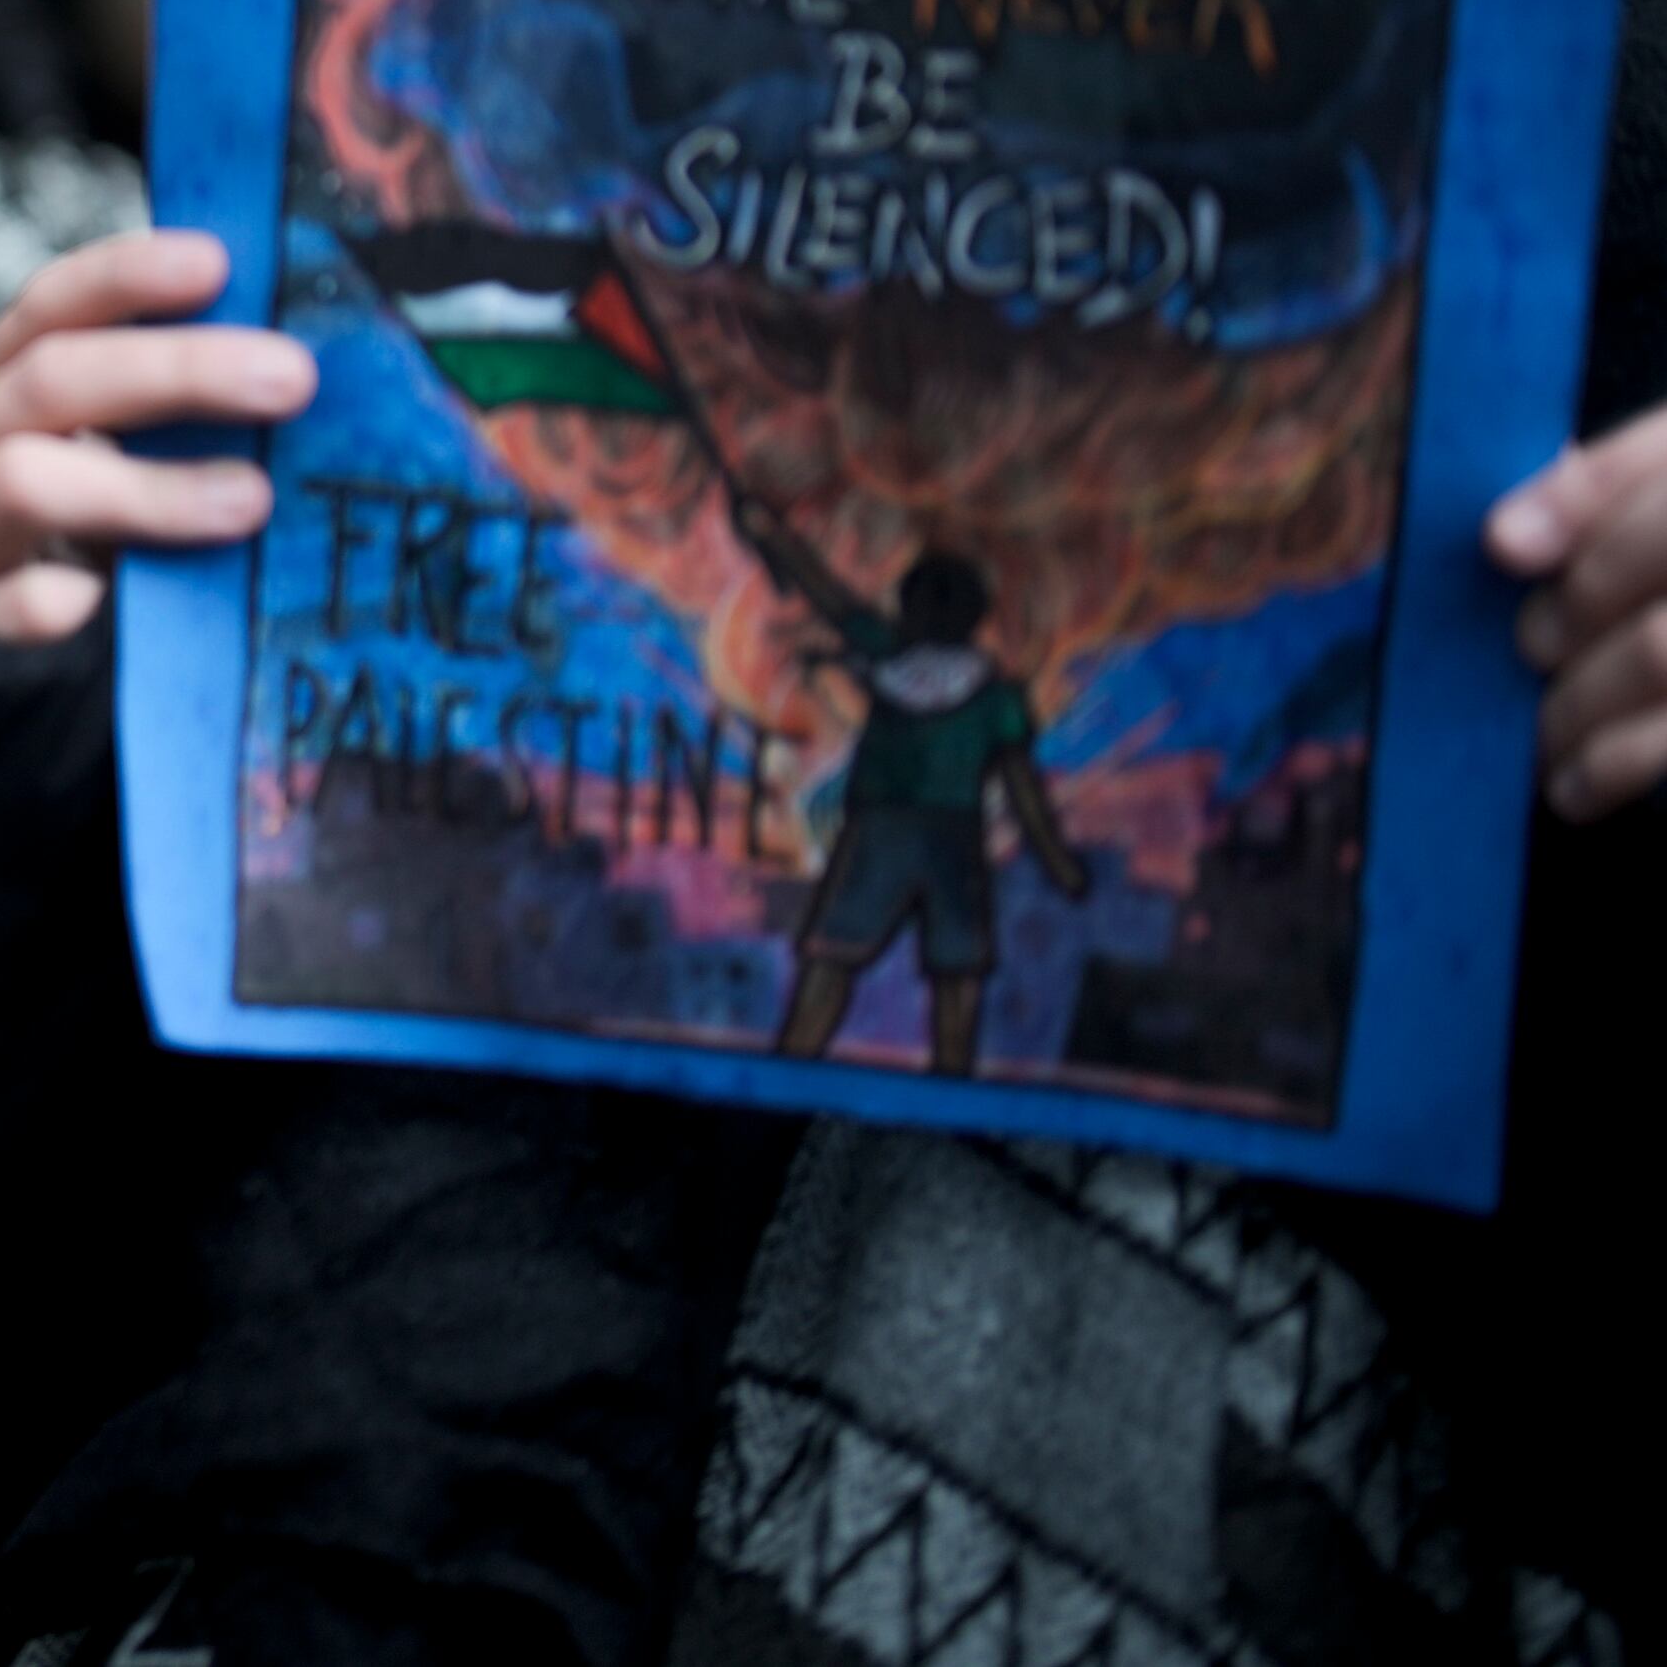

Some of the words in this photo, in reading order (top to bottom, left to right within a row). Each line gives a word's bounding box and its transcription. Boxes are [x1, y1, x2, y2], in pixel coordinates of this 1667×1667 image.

[813, 30, 983, 160] BE
[639, 126, 1225, 337] SILENCED!
[302, 476, 575, 656] FREE
[281, 658, 812, 866] PALESTINE
